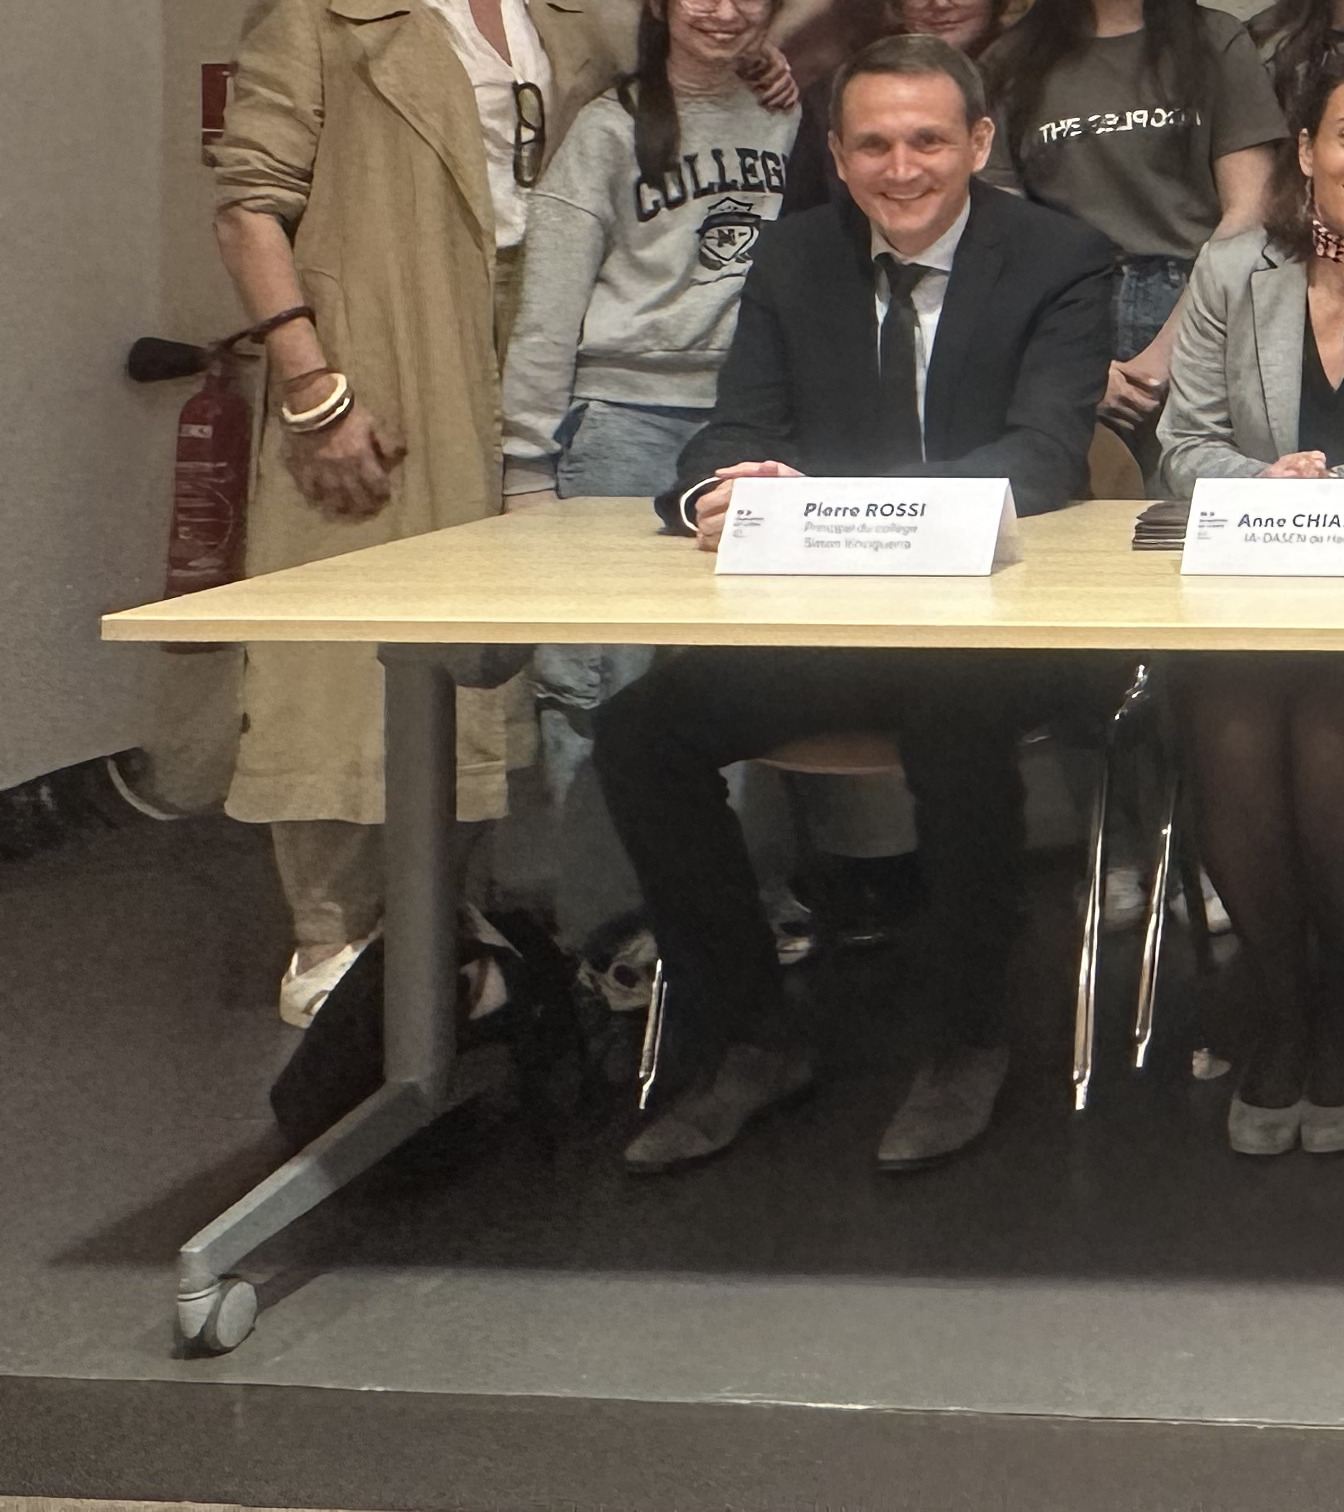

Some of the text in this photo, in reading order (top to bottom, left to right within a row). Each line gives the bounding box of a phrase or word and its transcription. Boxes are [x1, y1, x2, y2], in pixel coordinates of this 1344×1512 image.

[635, 147, 790, 223] COLLEG
[803, 502, 927, 517] Pierre ROSSI
[1237, 513, 1287, 528] Anne
